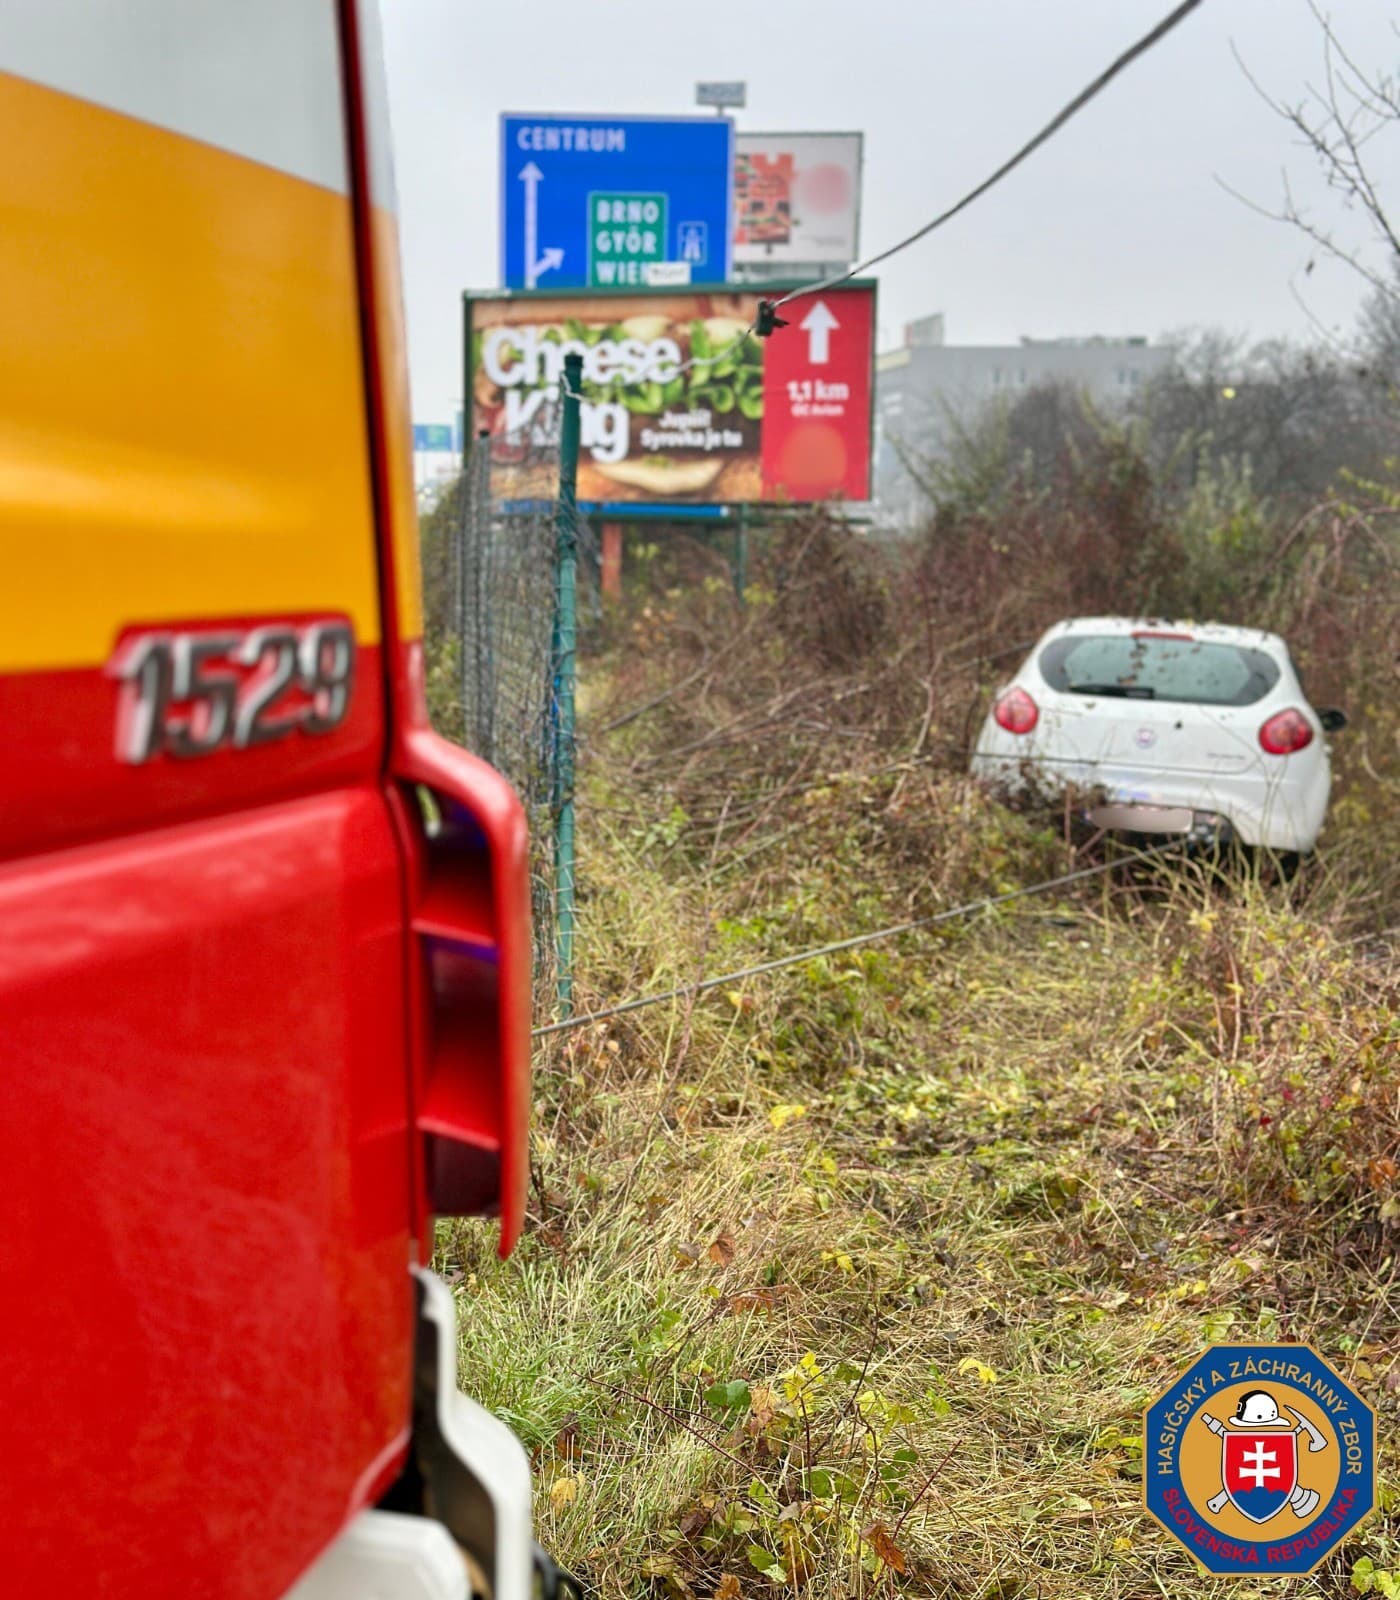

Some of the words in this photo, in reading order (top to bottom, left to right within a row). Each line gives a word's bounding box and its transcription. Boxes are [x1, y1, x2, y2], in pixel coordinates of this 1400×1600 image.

[517, 126, 626, 152] CENTRUM
[596, 199, 660, 225] BRNO
[814, 377, 850, 401] km
[105, 618, 354, 765] 1529
